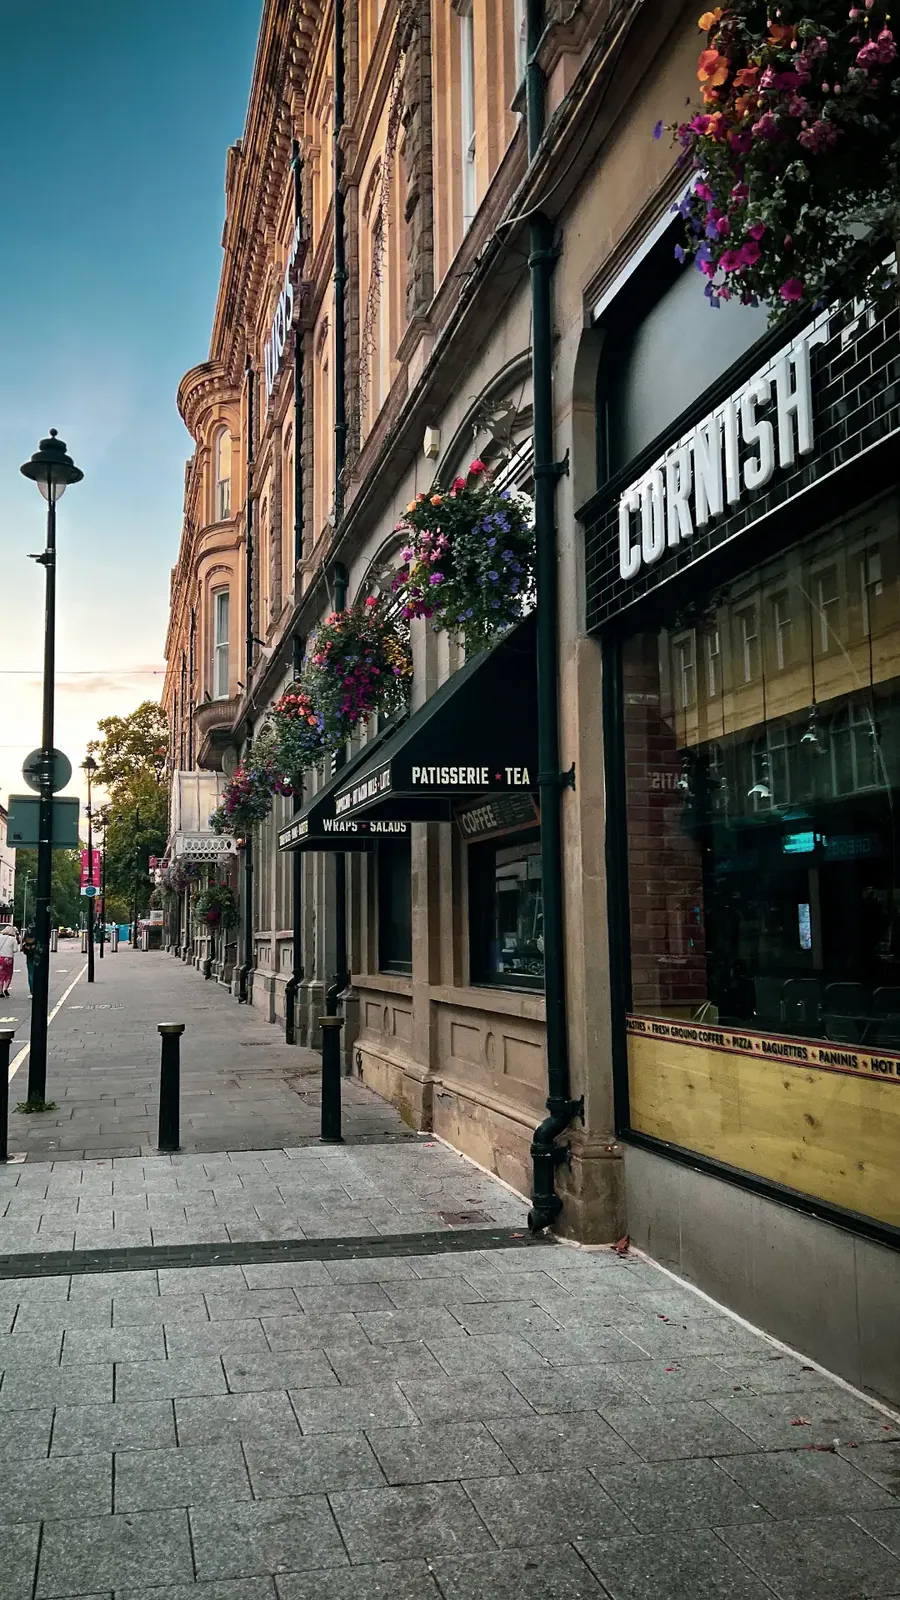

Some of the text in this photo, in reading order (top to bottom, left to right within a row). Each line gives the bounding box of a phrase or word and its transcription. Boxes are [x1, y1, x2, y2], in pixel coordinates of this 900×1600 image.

[618, 339, 814, 580] CORNISH
[412, 766, 530, 784] PATISSERIE TEA
[323, 819, 407, 832] WRAPS SALADS
[462, 804, 497, 833] COFFEE
[652, 1023, 669, 1035] FRESH
[671, 1026, 697, 1040] GROUND
[699, 1031, 724, 1046] COFFEE
[732, 1036, 753, 1050] PIZZA
[762, 1040, 808, 1060] BAGUETTES
[819, 1050, 858, 1068] PANINIS
[871, 1058, 894, 1073] HOT
